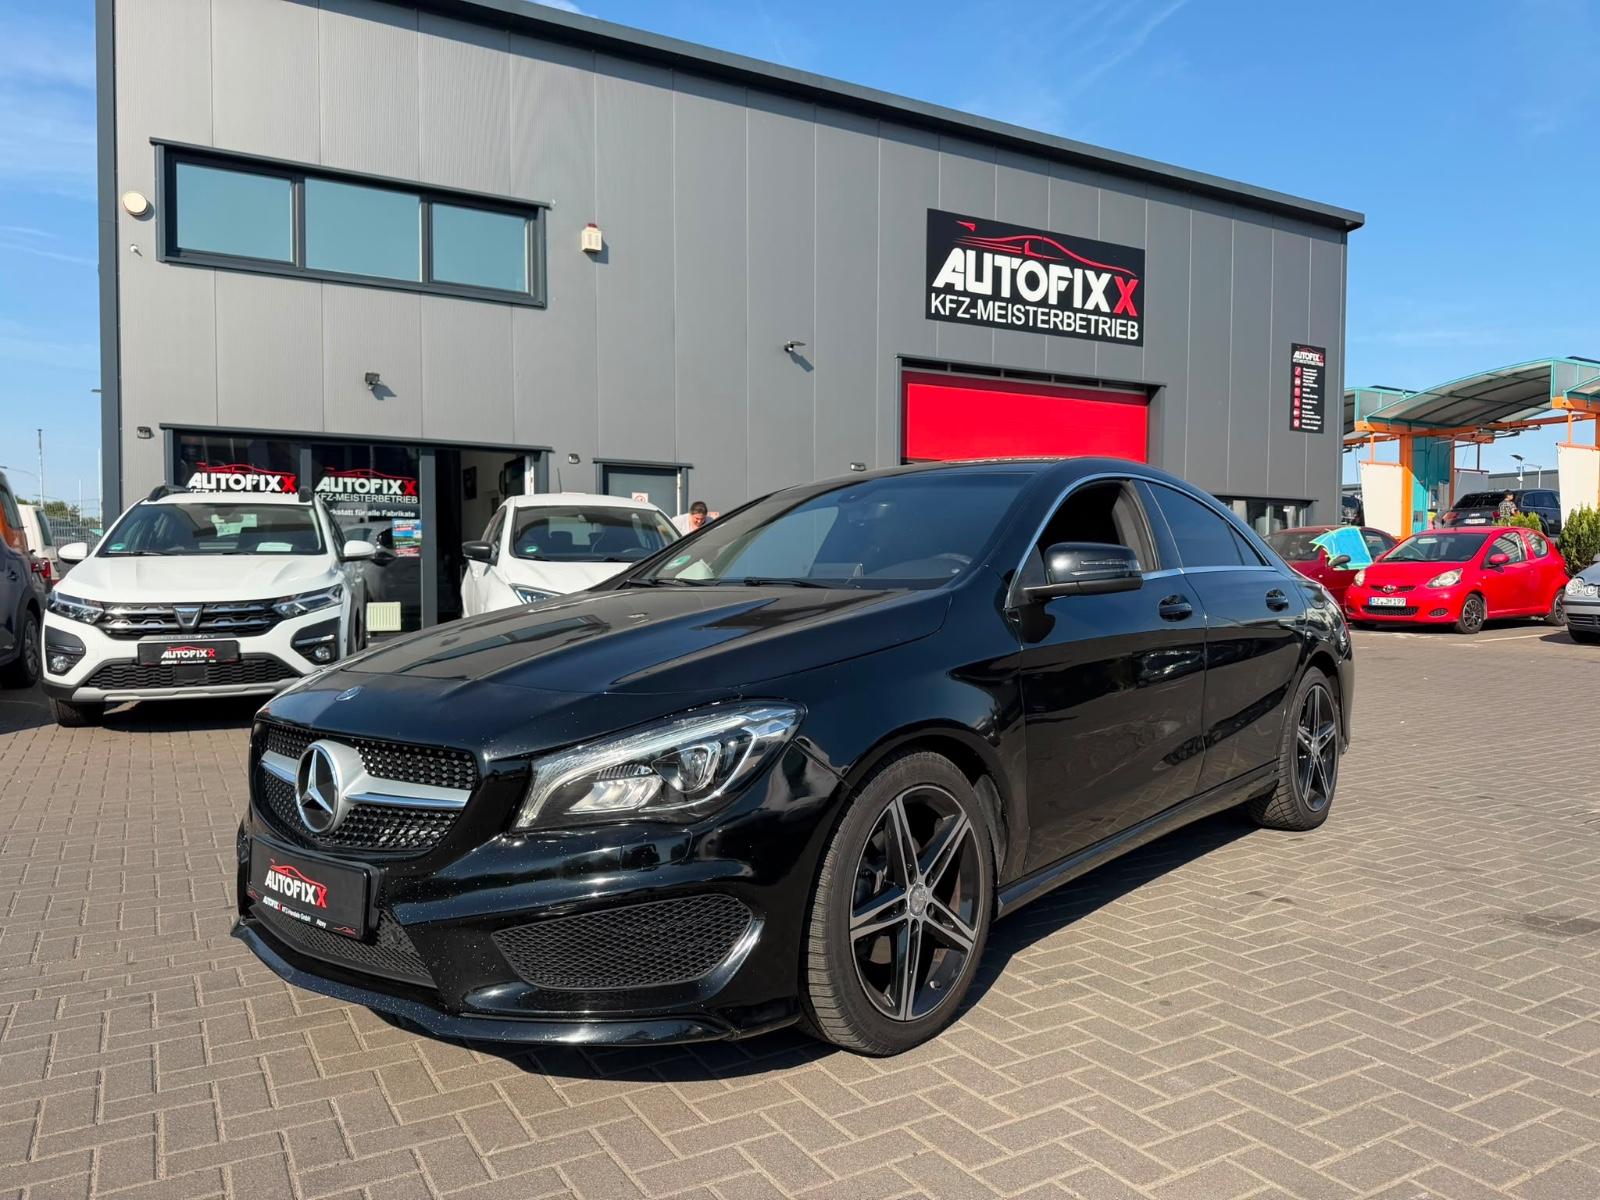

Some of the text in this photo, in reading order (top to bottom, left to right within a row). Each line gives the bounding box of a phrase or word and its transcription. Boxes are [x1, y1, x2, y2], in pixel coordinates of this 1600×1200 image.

[932, 247, 1139, 316] AUTOFIXX
[931, 293, 1139, 340] KFZ-MEISTERBETRIEB
[186, 472, 296, 492] AUTOFIXX
[315, 477, 416, 495] AUTOFIXX
[381, 510, 415, 518] Fabrikate
[265, 870, 327, 909] AUTOFIXX
